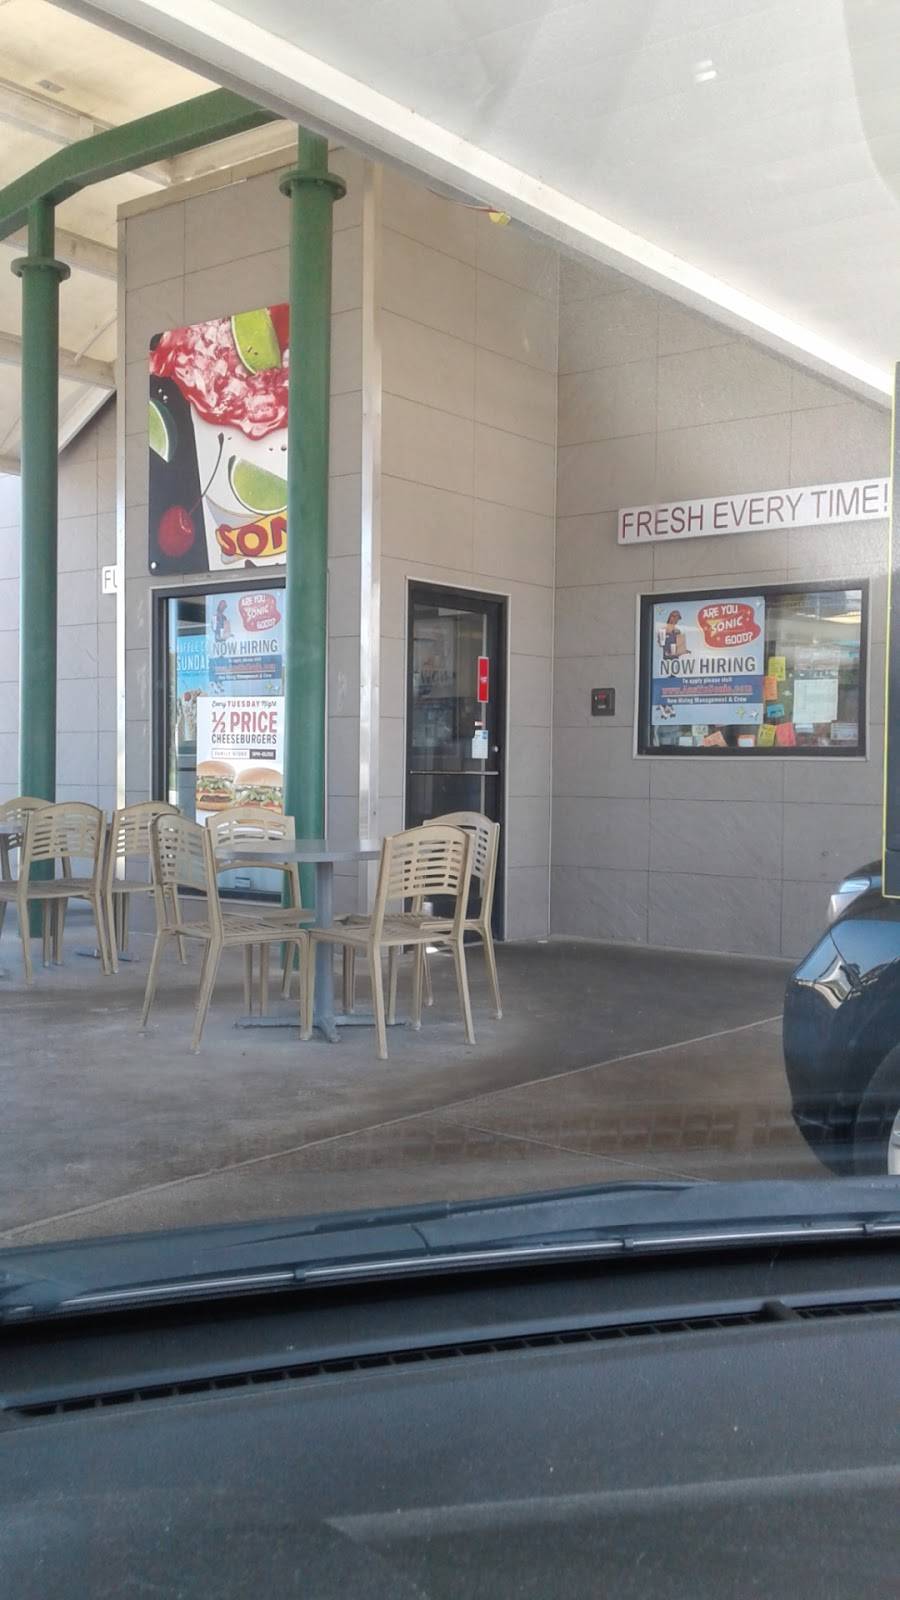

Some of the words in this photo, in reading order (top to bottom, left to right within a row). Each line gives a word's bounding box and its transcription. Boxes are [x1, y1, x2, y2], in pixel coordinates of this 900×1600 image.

[621, 504, 704, 540] FRESH
[713, 492, 803, 530] EVERY
[810, 482, 888, 519] TIME!
[703, 607, 720, 618] ARE
[721, 604, 738, 616] YOU
[711, 616, 743, 633] SONIC
[725, 632, 753, 645] GOOD?
[213, 641, 237, 656] NOW
[240, 639, 278, 655] HIRING
[660, 659, 695, 676] NOW
[699, 656, 756, 674] HIRING
[227, 700, 259, 708] TUESDAY
[230, 711, 278, 733] PRICE
[211, 733, 277, 745] CHEESEBURGERS
